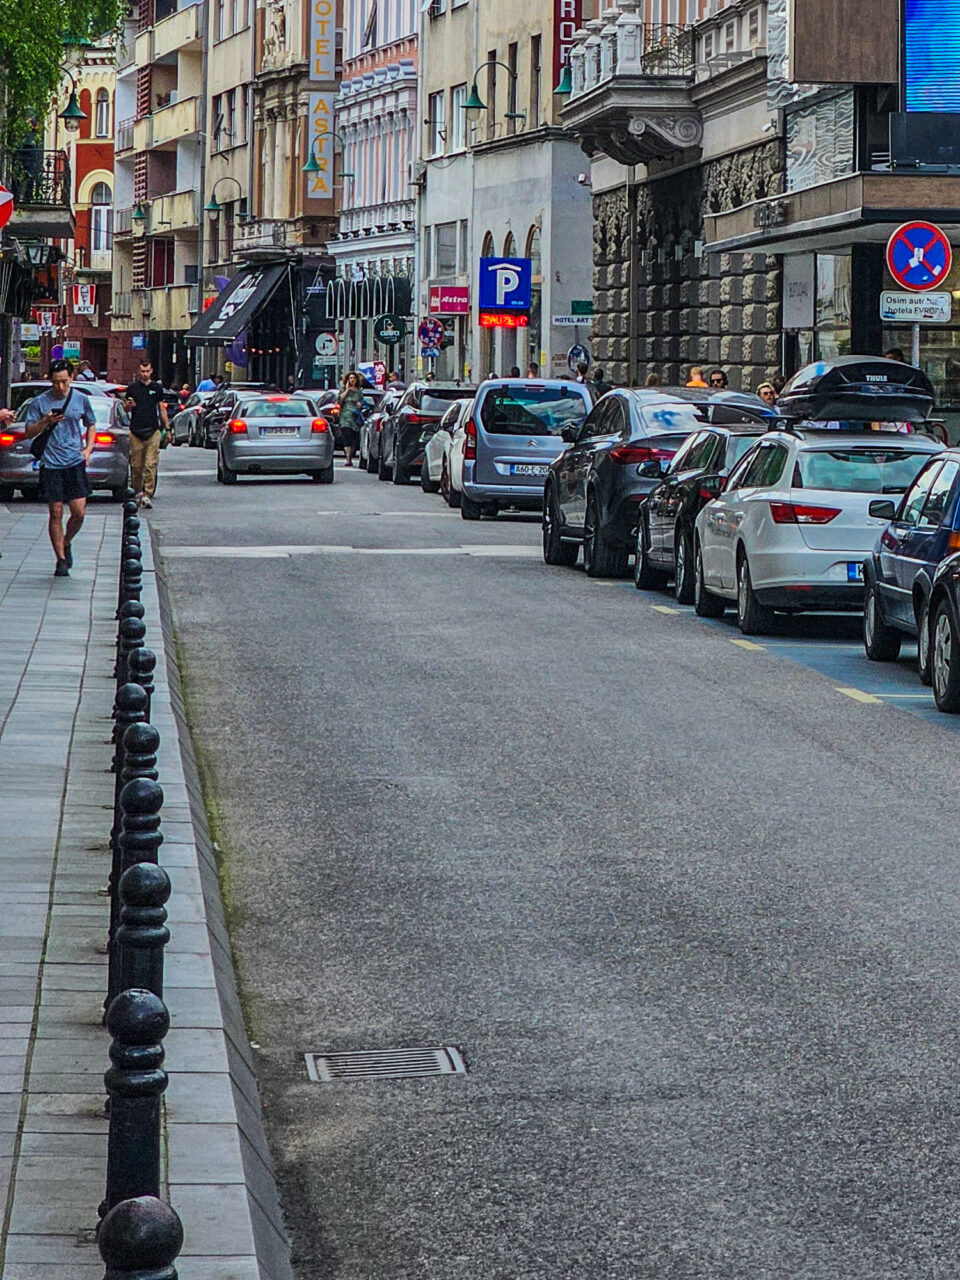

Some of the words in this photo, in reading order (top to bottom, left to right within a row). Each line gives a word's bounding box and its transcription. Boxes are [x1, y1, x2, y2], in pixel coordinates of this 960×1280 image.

[311, 98, 330, 194] ASTRA
[441, 295, 468, 304] Astra
[886, 296, 907, 304] Osim
[865, 374, 888, 382] THULE
